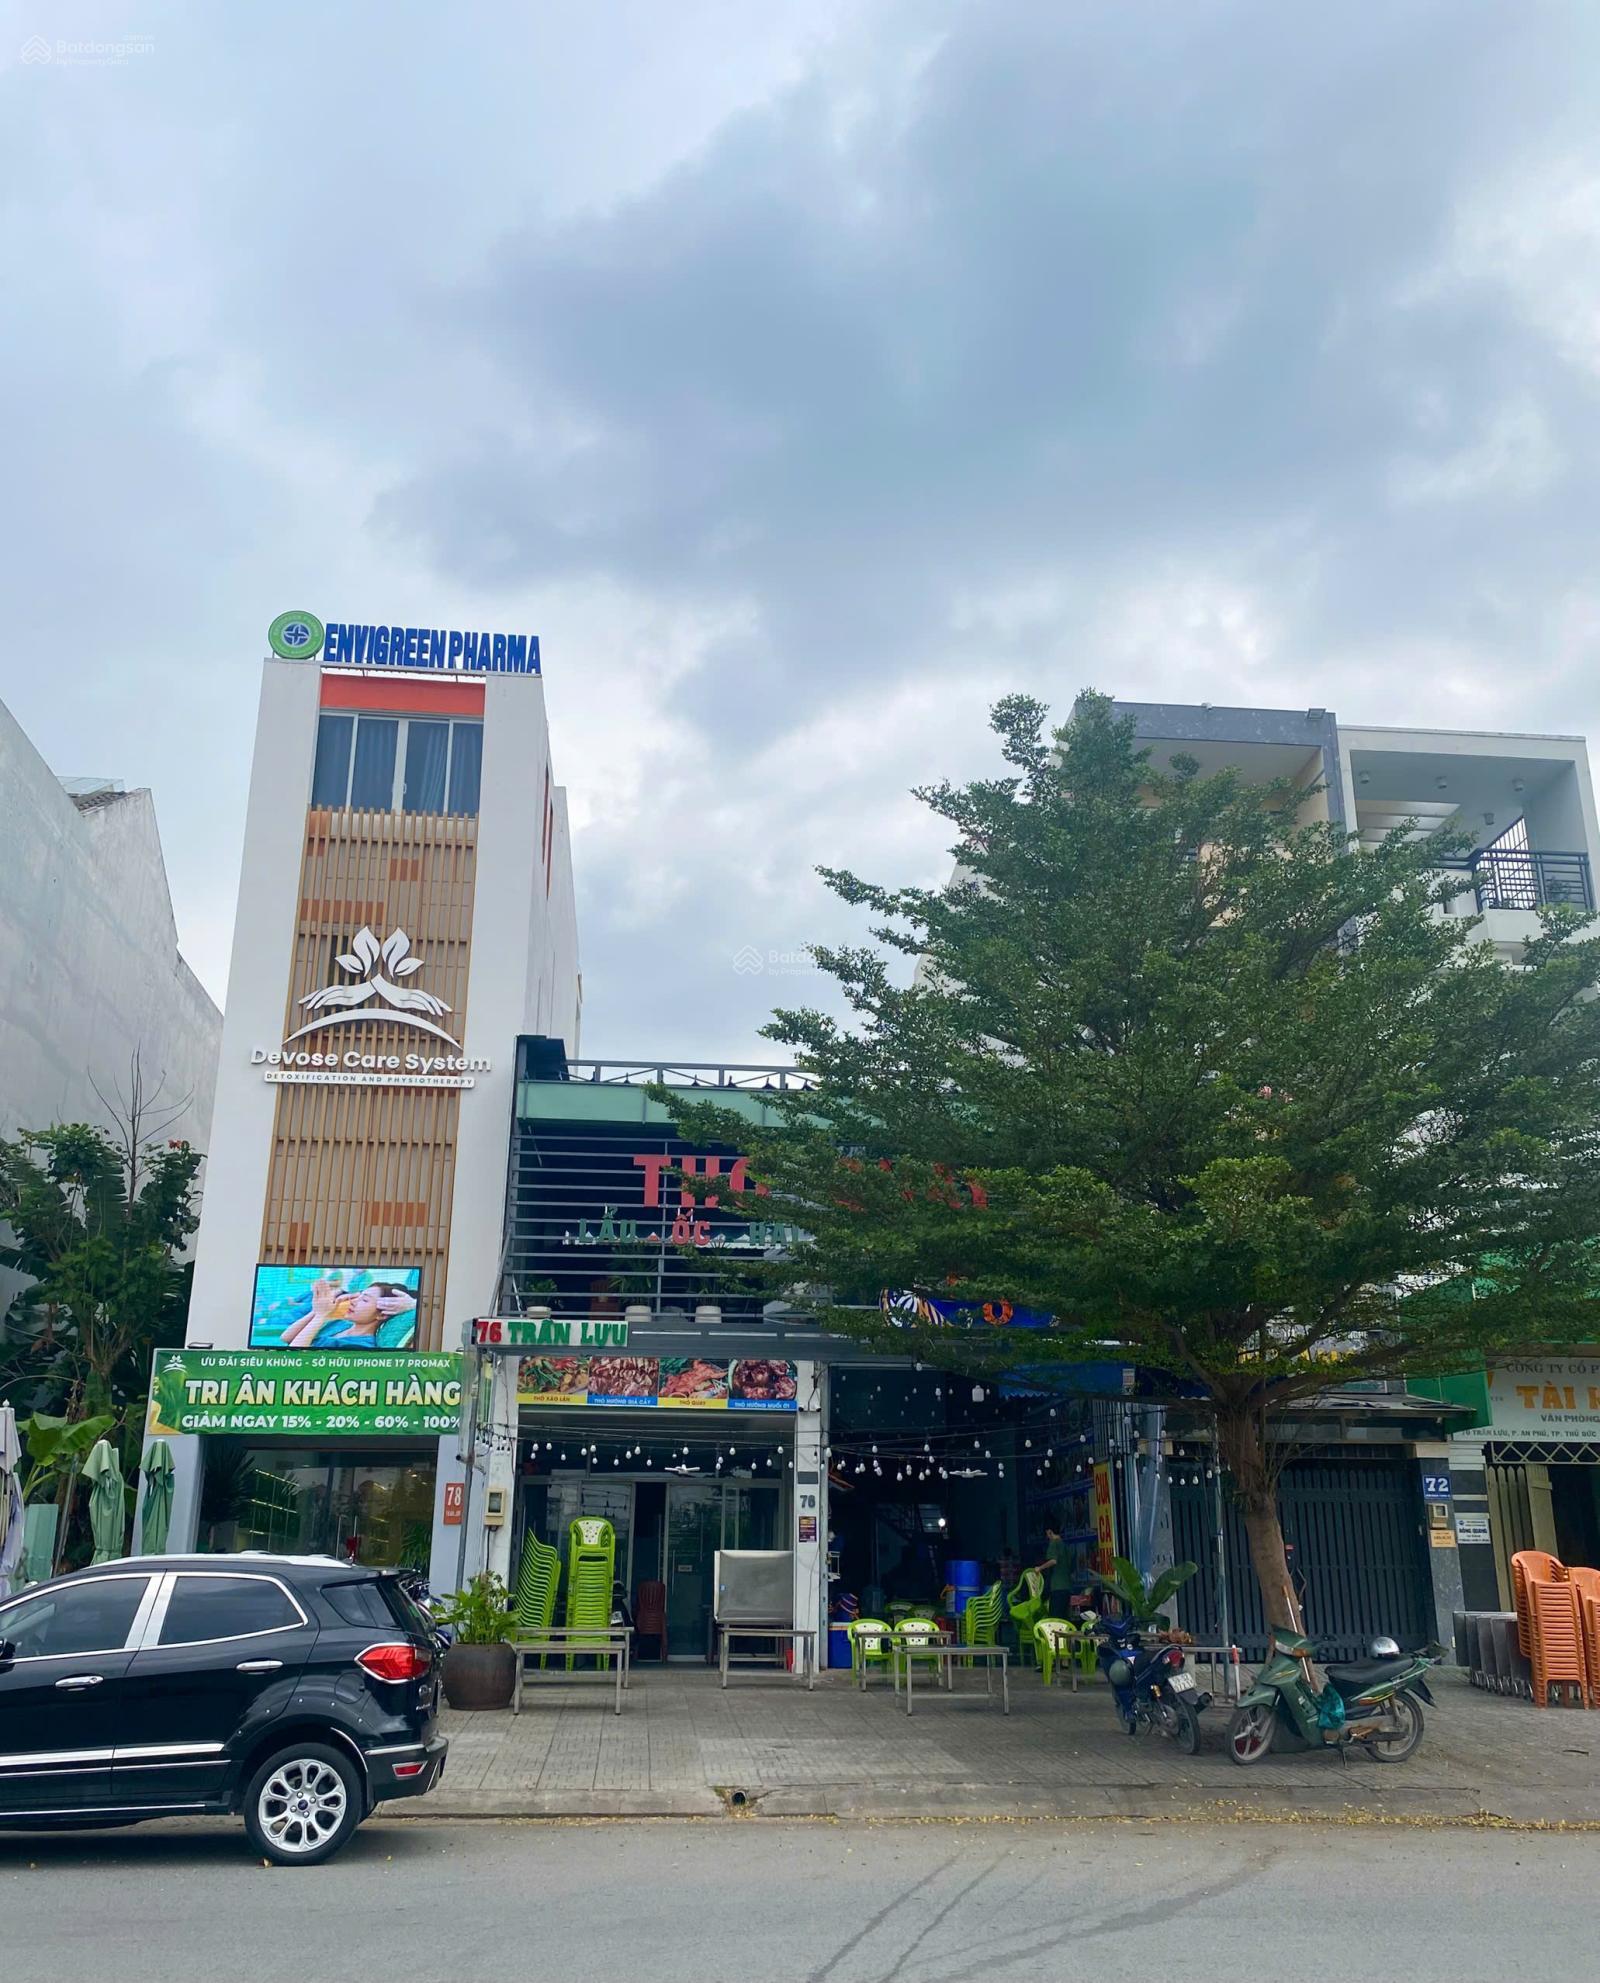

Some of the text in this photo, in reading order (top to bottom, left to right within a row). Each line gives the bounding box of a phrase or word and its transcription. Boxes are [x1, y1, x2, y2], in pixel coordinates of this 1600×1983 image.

[323, 623, 447, 668] ENVIGREEN
[448, 630, 541, 674] PHARMA
[251, 1046, 491, 1075] Devose Care System
[266, 1073, 356, 1081] DETOXIFICATION
[388, 1076, 472, 1085] PHYSIOTHERAPY
[476, 1321, 502, 1343] 76
[200, 1357, 215, 1367] ƯU
[218, 1356, 237, 1367] ĐÃI
[240, 1356, 263, 1367] SIÊU
[266, 1356, 303, 1368] KHỦNG
[312, 1355, 326, 1367] SỞ
[329, 1356, 351, 1368] HỮU
[353, 1359, 392, 1368] IPHONE
[395, 1359, 404, 1367] 17
[407, 1359, 450, 1368] PROMAX
[1549, 1363, 1563, 1374] TY
[185, 1373, 462, 1406] TRI ÂN KHÁCH HÀNG
[1516, 1380, 1577, 1410] TÀI
[181, 1410, 226, 1428] GIẢM
[231, 1415, 278, 1428] NGAY
[281, 1415, 312, 1428] 15%
[326, 1415, 360, 1428] 20%
[374, 1416, 409, 1428] 60%
[1425, 1477, 1449, 1492] 72
[447, 1486, 462, 1506] 78
